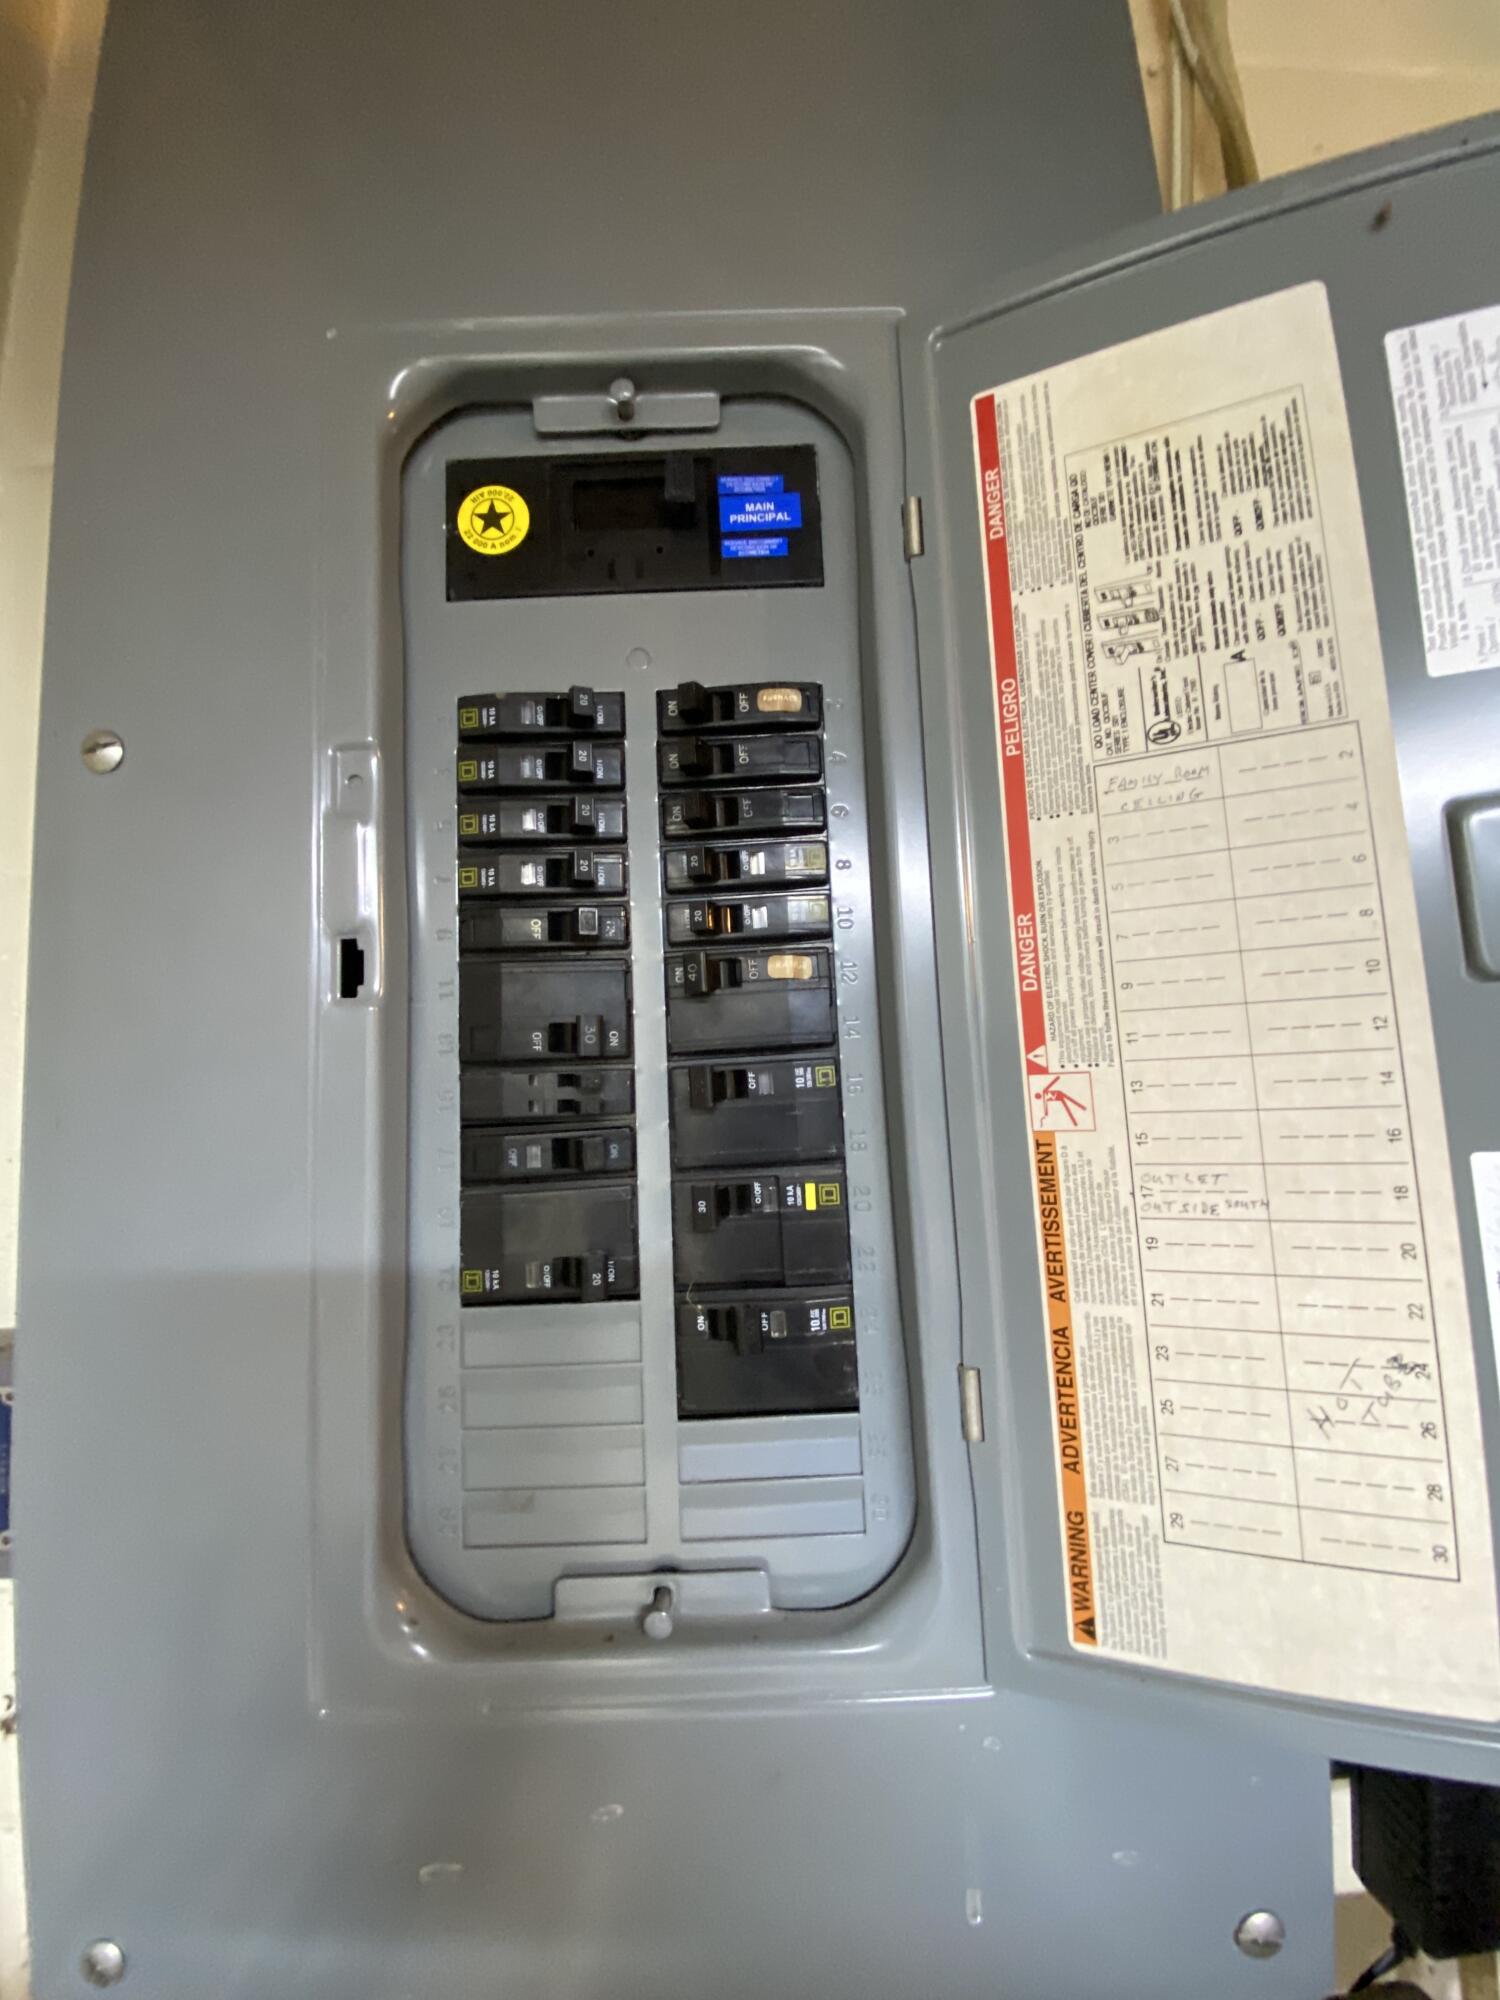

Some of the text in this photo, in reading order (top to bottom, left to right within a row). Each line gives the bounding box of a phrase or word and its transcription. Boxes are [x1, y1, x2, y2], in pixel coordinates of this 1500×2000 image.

[745, 501, 774, 512] MAIN
[984, 466, 1004, 540] DANGER
[1070, 488, 1081, 519] CARGA
[730, 511, 792, 524] PRINCIPAL
[1073, 520, 1082, 532] DE
[1074, 533, 1085, 568] CENTRO
[1078, 570, 1088, 587] DEL
[1080, 588, 1092, 632] CUBIERTA
[1084, 638, 1095, 669] COVER
[1229, 649, 1246, 663] A
[1087, 670, 1099, 706] CENTER
[580, 694, 588, 706] 20
[739, 692, 749, 712] OFF
[668, 701, 678, 716] ON
[999, 676, 1021, 756] PELIGRO
[1091, 707, 1101, 732] LOAD
[1093, 734, 1103, 749] QO
[578, 750, 587, 762] 20
[668, 753, 679, 769] ON
[739, 744, 750, 764] OFF
[1338, 748, 1354, 759] 2
[1119, 786, 1203, 811] CEILING
[1344, 800, 1360, 810] 4
[582, 804, 590, 816] 20
[672, 806, 682, 822] ON
[742, 797, 753, 818] OFF
[830, 804, 849, 819] 6
[1107, 835, 1120, 843] 3
[580, 860, 588, 872] 20
[690, 855, 699, 866] 20
[835, 858, 852, 871] 8
[1351, 853, 1367, 863] 6
[1111, 882, 1124, 891] 5
[694, 910, 702, 922] 20
[837, 906, 854, 930] 10
[1360, 907, 1375, 917] 8
[530, 919, 542, 940] OFF
[1039, 913, 1047, 933] BURN
[1116, 932, 1129, 941] 7
[1016, 912, 1038, 991] DANGER
[688, 964, 697, 982] 40
[748, 959, 759, 980] OFF
[840, 960, 860, 985] 12
[1365, 958, 1382, 974] 10
[675, 967, 684, 984] ON
[1043, 963, 1053, 998] ELECTRIC
[1120, 981, 1133, 989] 9
[1046, 1000, 1054, 1009] OF
[1047, 1011, 1057, 1041] HAZARD
[1372, 1014, 1388, 1031] 12
[532, 1032, 542, 1052] OFF
[585, 1025, 596, 1044] 30
[609, 1031, 619, 1047] ON
[1125, 1031, 1139, 1044] 11
[748, 1072, 756, 1088] OFF
[795, 1078, 804, 1088] 10
[1378, 1069, 1395, 1086] 14
[1129, 1079, 1143, 1093] 13
[1135, 1131, 1149, 1146] 15
[1385, 1127, 1403, 1143] 16
[508, 1148, 518, 1168] OFF
[610, 1144, 618, 1159] ON
[1139, 1173, 1229, 1184] OUTLET
[1139, 1184, 1154, 1198] 17
[1392, 1184, 1410, 1200] 18
[698, 1200, 706, 1213] 30
[1035, 1139, 1066, 1302] AVERTISSEMENT
[1145, 1235, 1159, 1250] 19
[1399, 1242, 1416, 1259] 20
[592, 1272, 601, 1286] 20
[1150, 1291, 1164, 1307] 21
[1406, 1302, 1423, 1320] 22
[697, 1316, 705, 1331] ON
[811, 1320, 821, 1332] 10
[1155, 1344, 1169, 1361] 23
[1051, 1325, 1080, 1474] ADVERTENCIA
[1160, 1398, 1174, 1415] 25
[1419, 1420, 1437, 1439] 26
[1164, 1455, 1179, 1472] 27
[1425, 1482, 1443, 1501] 28
[1169, 1510, 1184, 1529] 29
[1066, 1509, 1091, 1613] WARNING
[1431, 1543, 1450, 1564] 30
